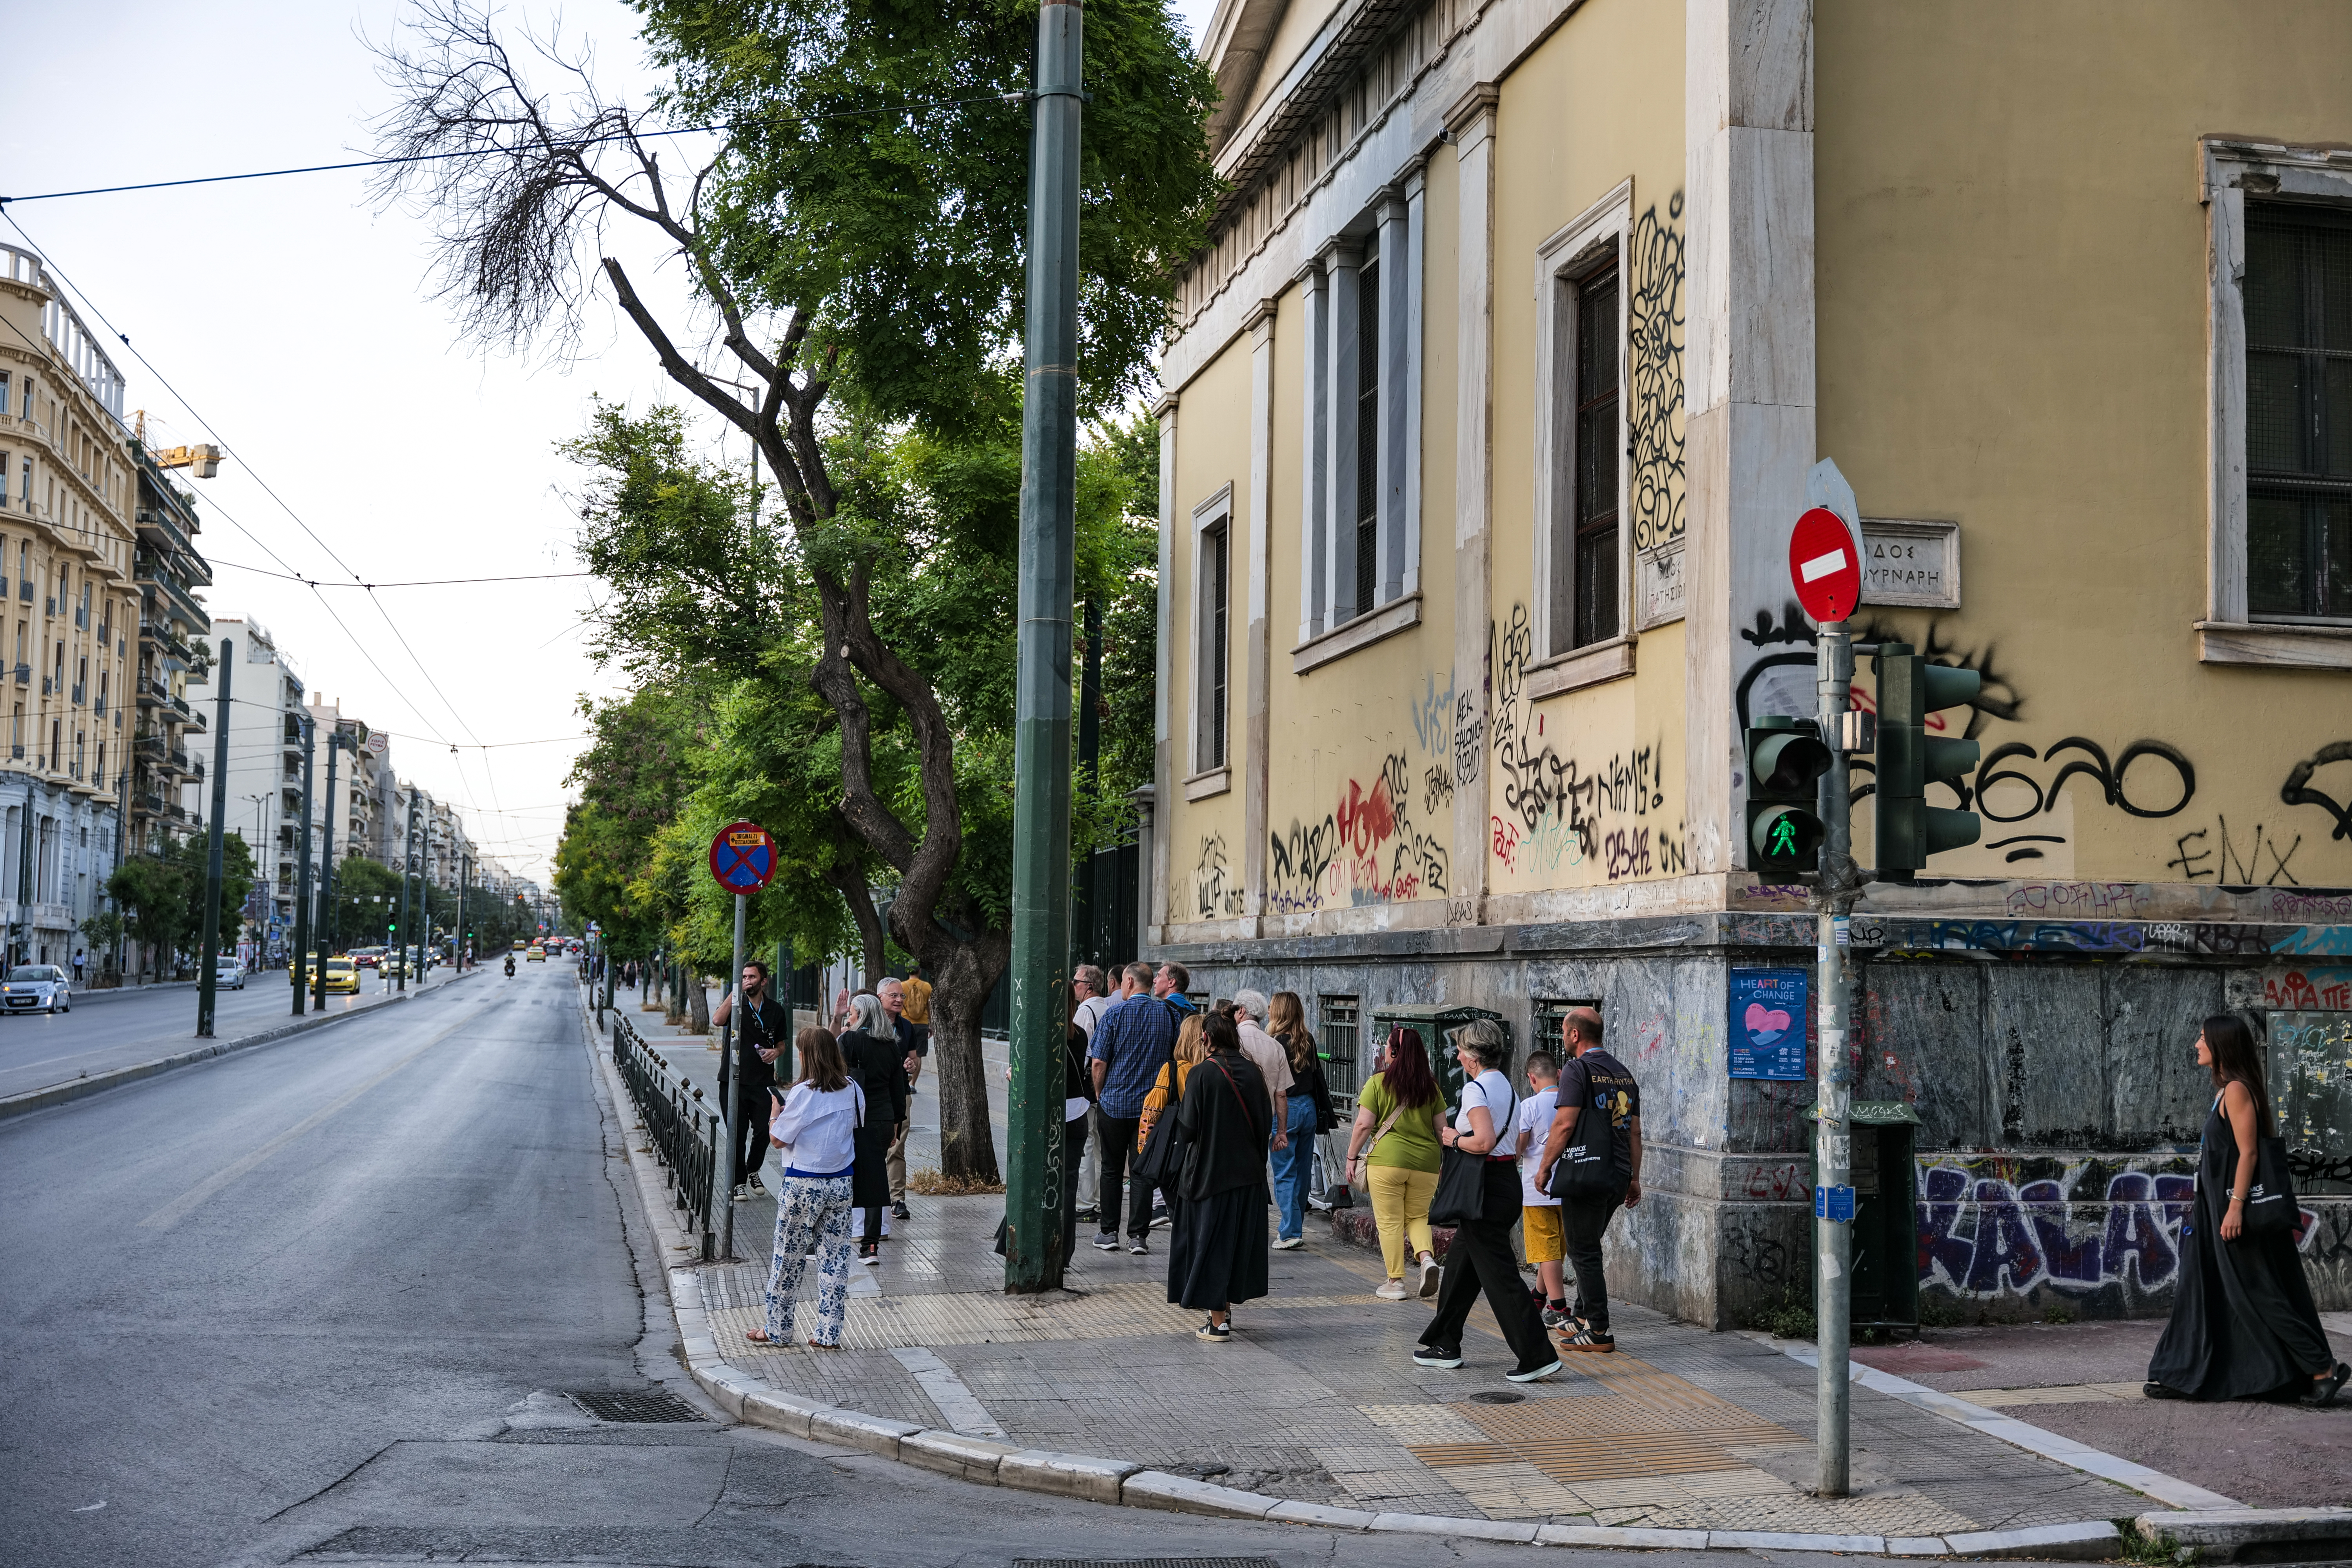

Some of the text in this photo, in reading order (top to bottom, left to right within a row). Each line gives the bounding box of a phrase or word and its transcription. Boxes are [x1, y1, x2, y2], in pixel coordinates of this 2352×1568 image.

[1864, 544, 1914, 559] ΔΟΣ
[1864, 569, 1939, 585] ΥΡΝΑΡΗ
[1650, 583, 1685, 605] ΠΑΤΗΣΙΩ
[1740, 979, 1795, 990] HEART OF
[1753, 990, 1795, 1000] CHANGE
[1592, 1075, 1613, 1084] EARTH
